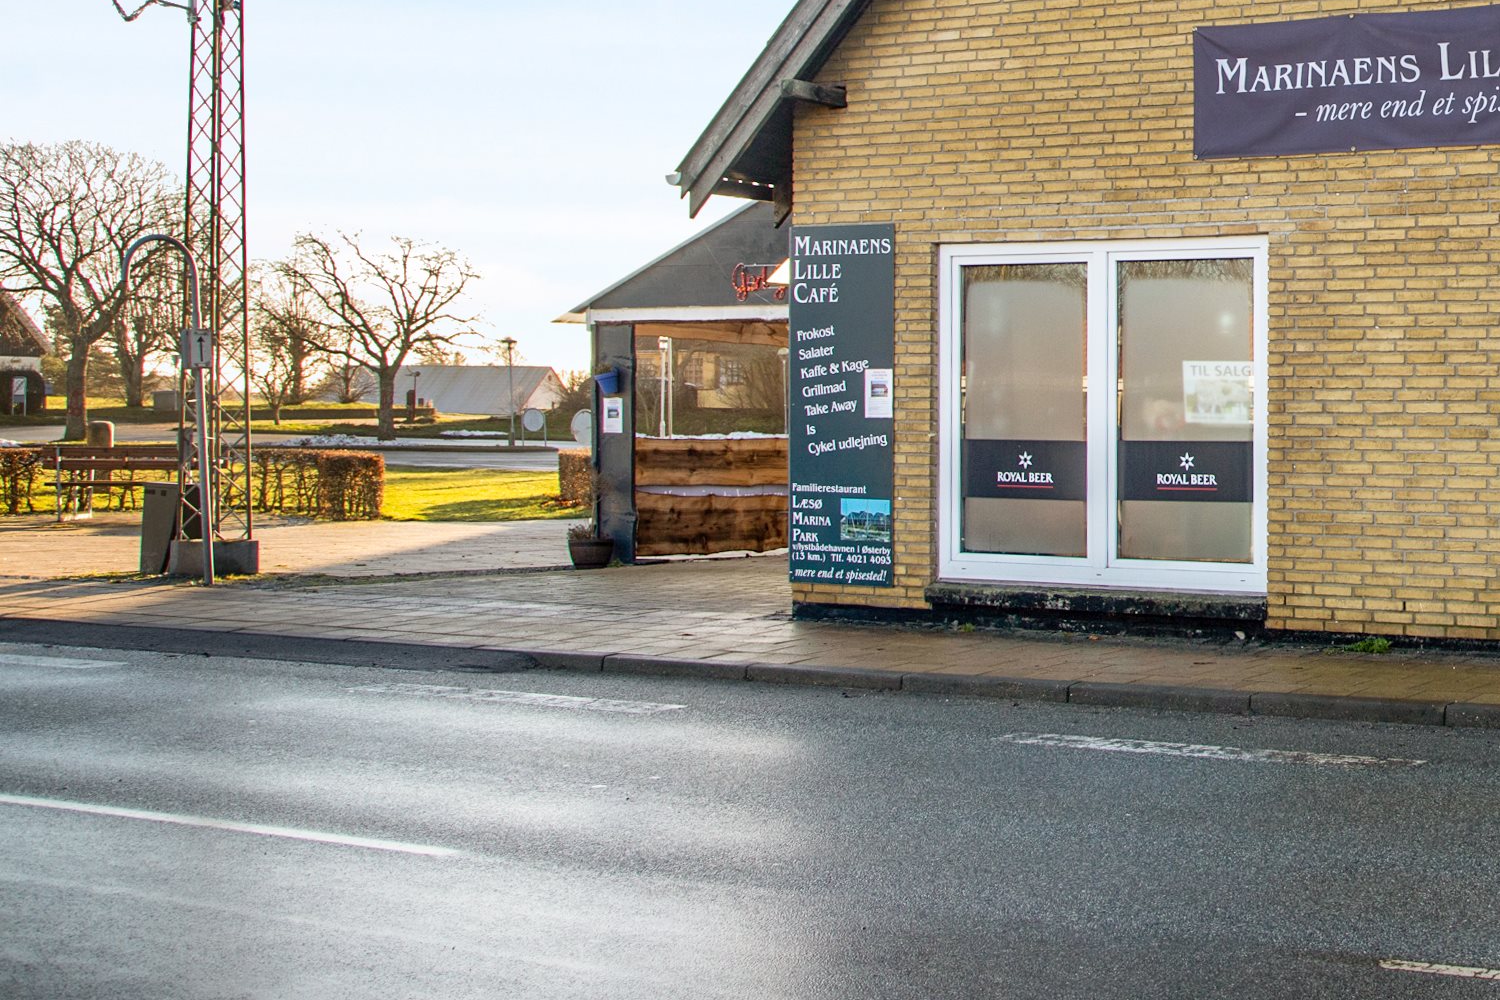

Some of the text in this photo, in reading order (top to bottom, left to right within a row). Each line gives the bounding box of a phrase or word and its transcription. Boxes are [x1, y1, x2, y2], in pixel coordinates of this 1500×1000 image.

[1215, 53, 1421, 95] MARINAENS
[1316, 102, 1373, 122] mere
[1380, 90, 1426, 119] end
[1432, 95, 1456, 116] et
[794, 235, 891, 257] MARINAENS
[794, 260, 842, 280] LILLE
[793, 282, 839, 304] CAFÉ
[797, 325, 835, 342] Frokost
[799, 345, 835, 360] Salater
[800, 359, 870, 379] Kaffe & Kage
[1190, 365, 1210, 377] TIL
[802, 380, 846, 398] Grillmad
[804, 404, 829, 417] Take
[831, 400, 857, 412] Away
[806, 424, 816, 435] Is
[808, 434, 888, 456] Cykel udlejning
[997, 471, 1054, 483] ROYAL BEER
[1157, 473, 1217, 485] ROYAL BEER
[792, 482, 867, 494] Familierestaurant
[792, 512, 831, 526] MARINA
[793, 529, 819, 542] PARK
[794, 568, 815, 577] mere
[817, 567, 834, 578] end
[835, 569, 844, 579] et
[845, 568, 887, 583] spisested!
